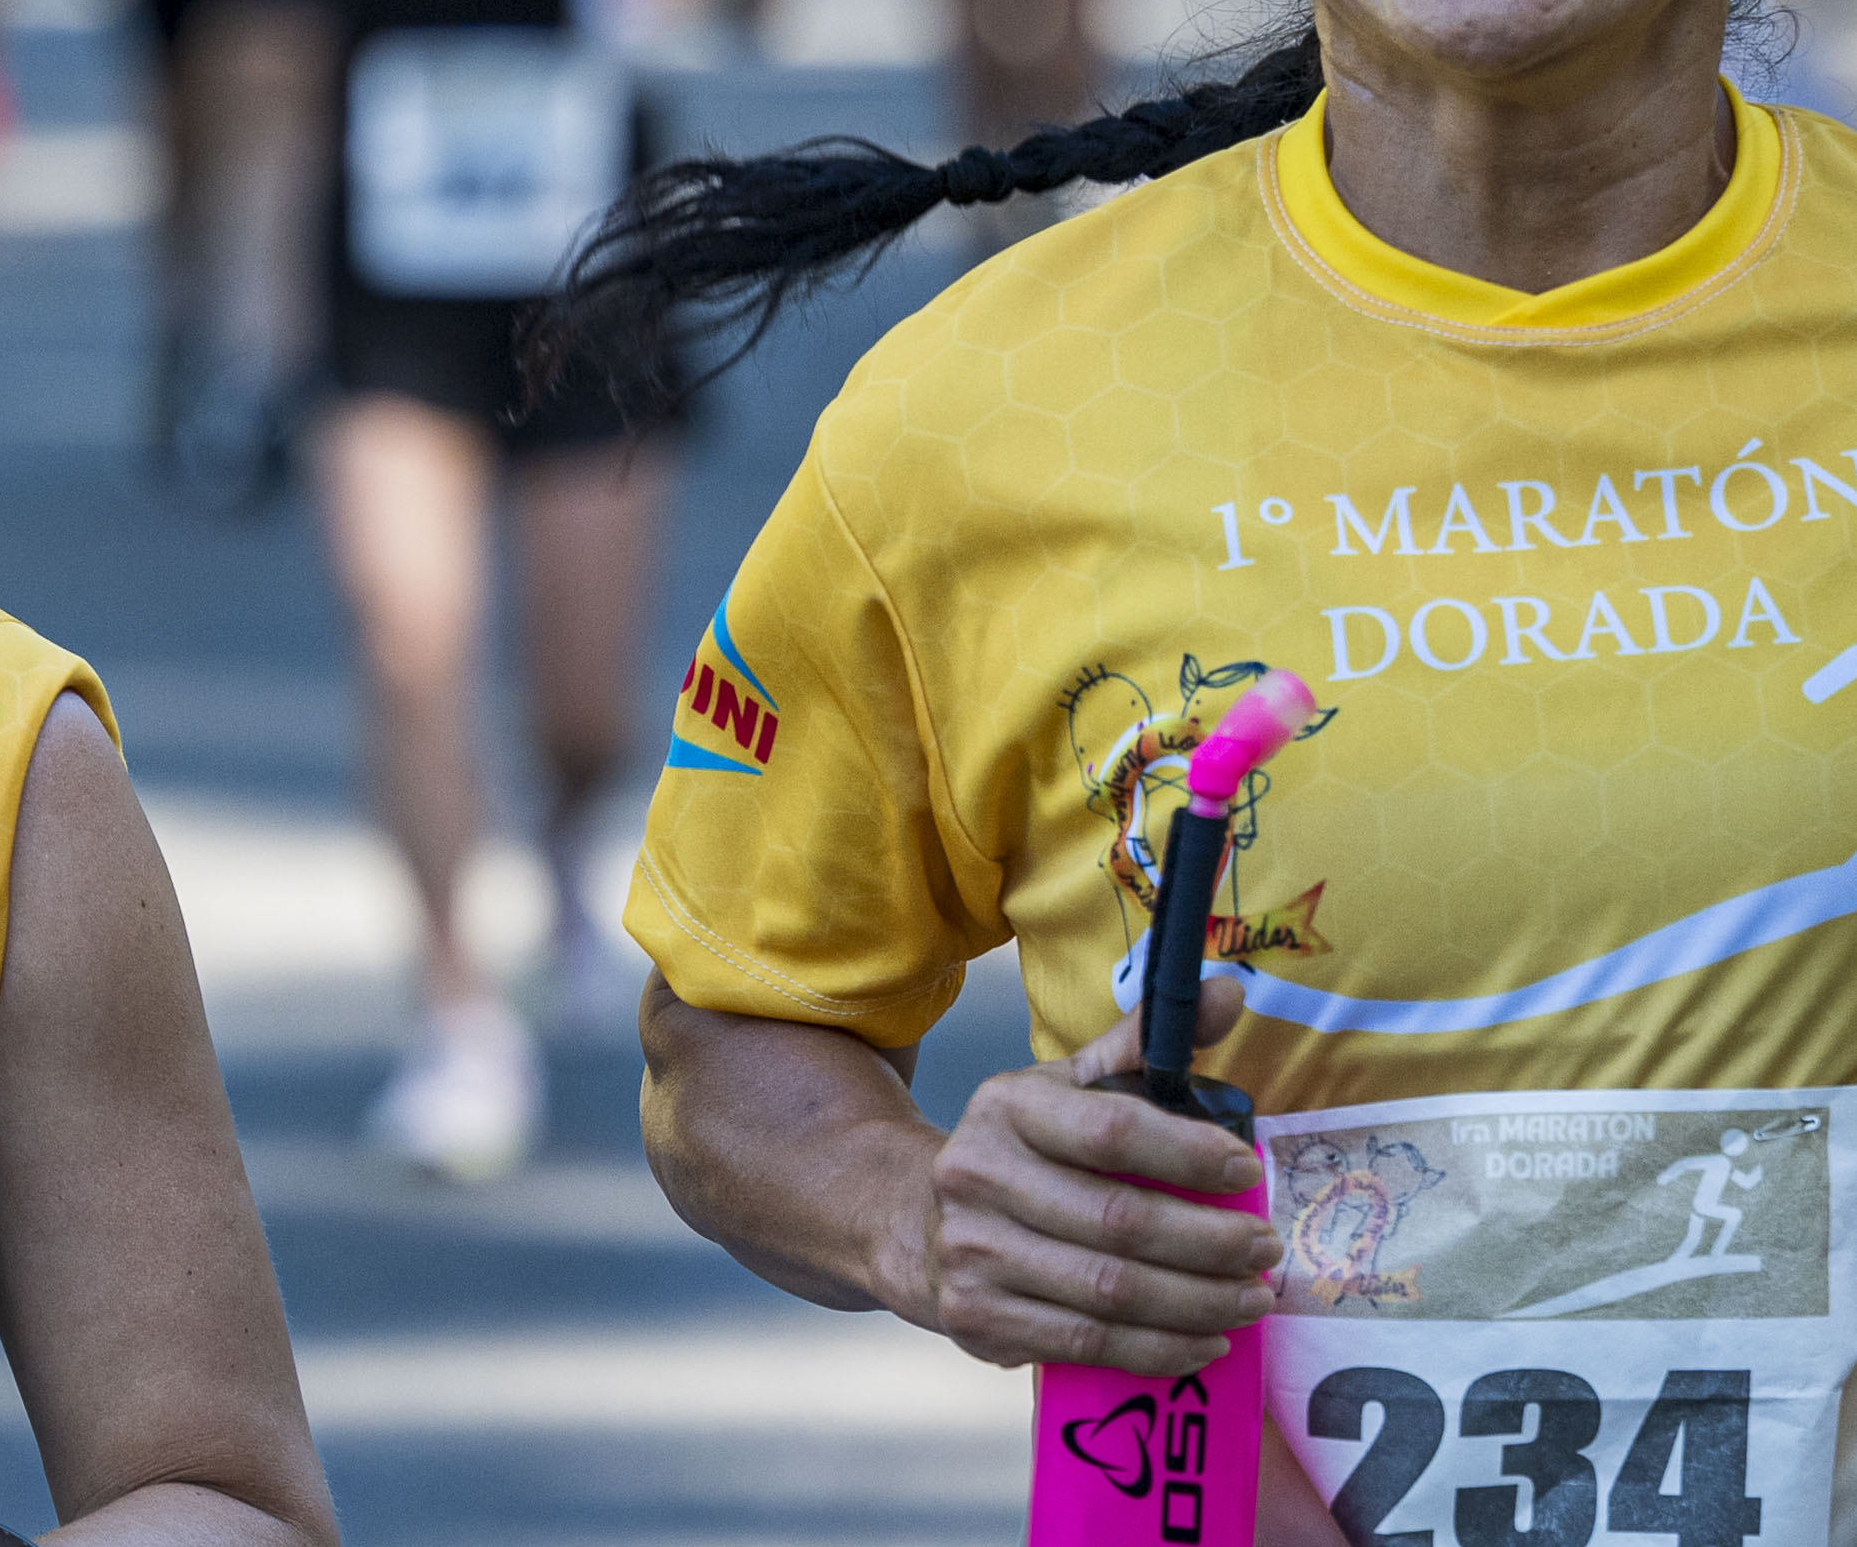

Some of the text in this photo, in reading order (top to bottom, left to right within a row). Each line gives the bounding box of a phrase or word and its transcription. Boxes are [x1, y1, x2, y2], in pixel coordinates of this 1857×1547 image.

[1325, 437, 1857, 557] MARATÓN
[1324, 577, 1801, 683] DORADA
[1498, 1112, 1658, 1143] MARATON
[1485, 1150, 1620, 1180] DORADA
